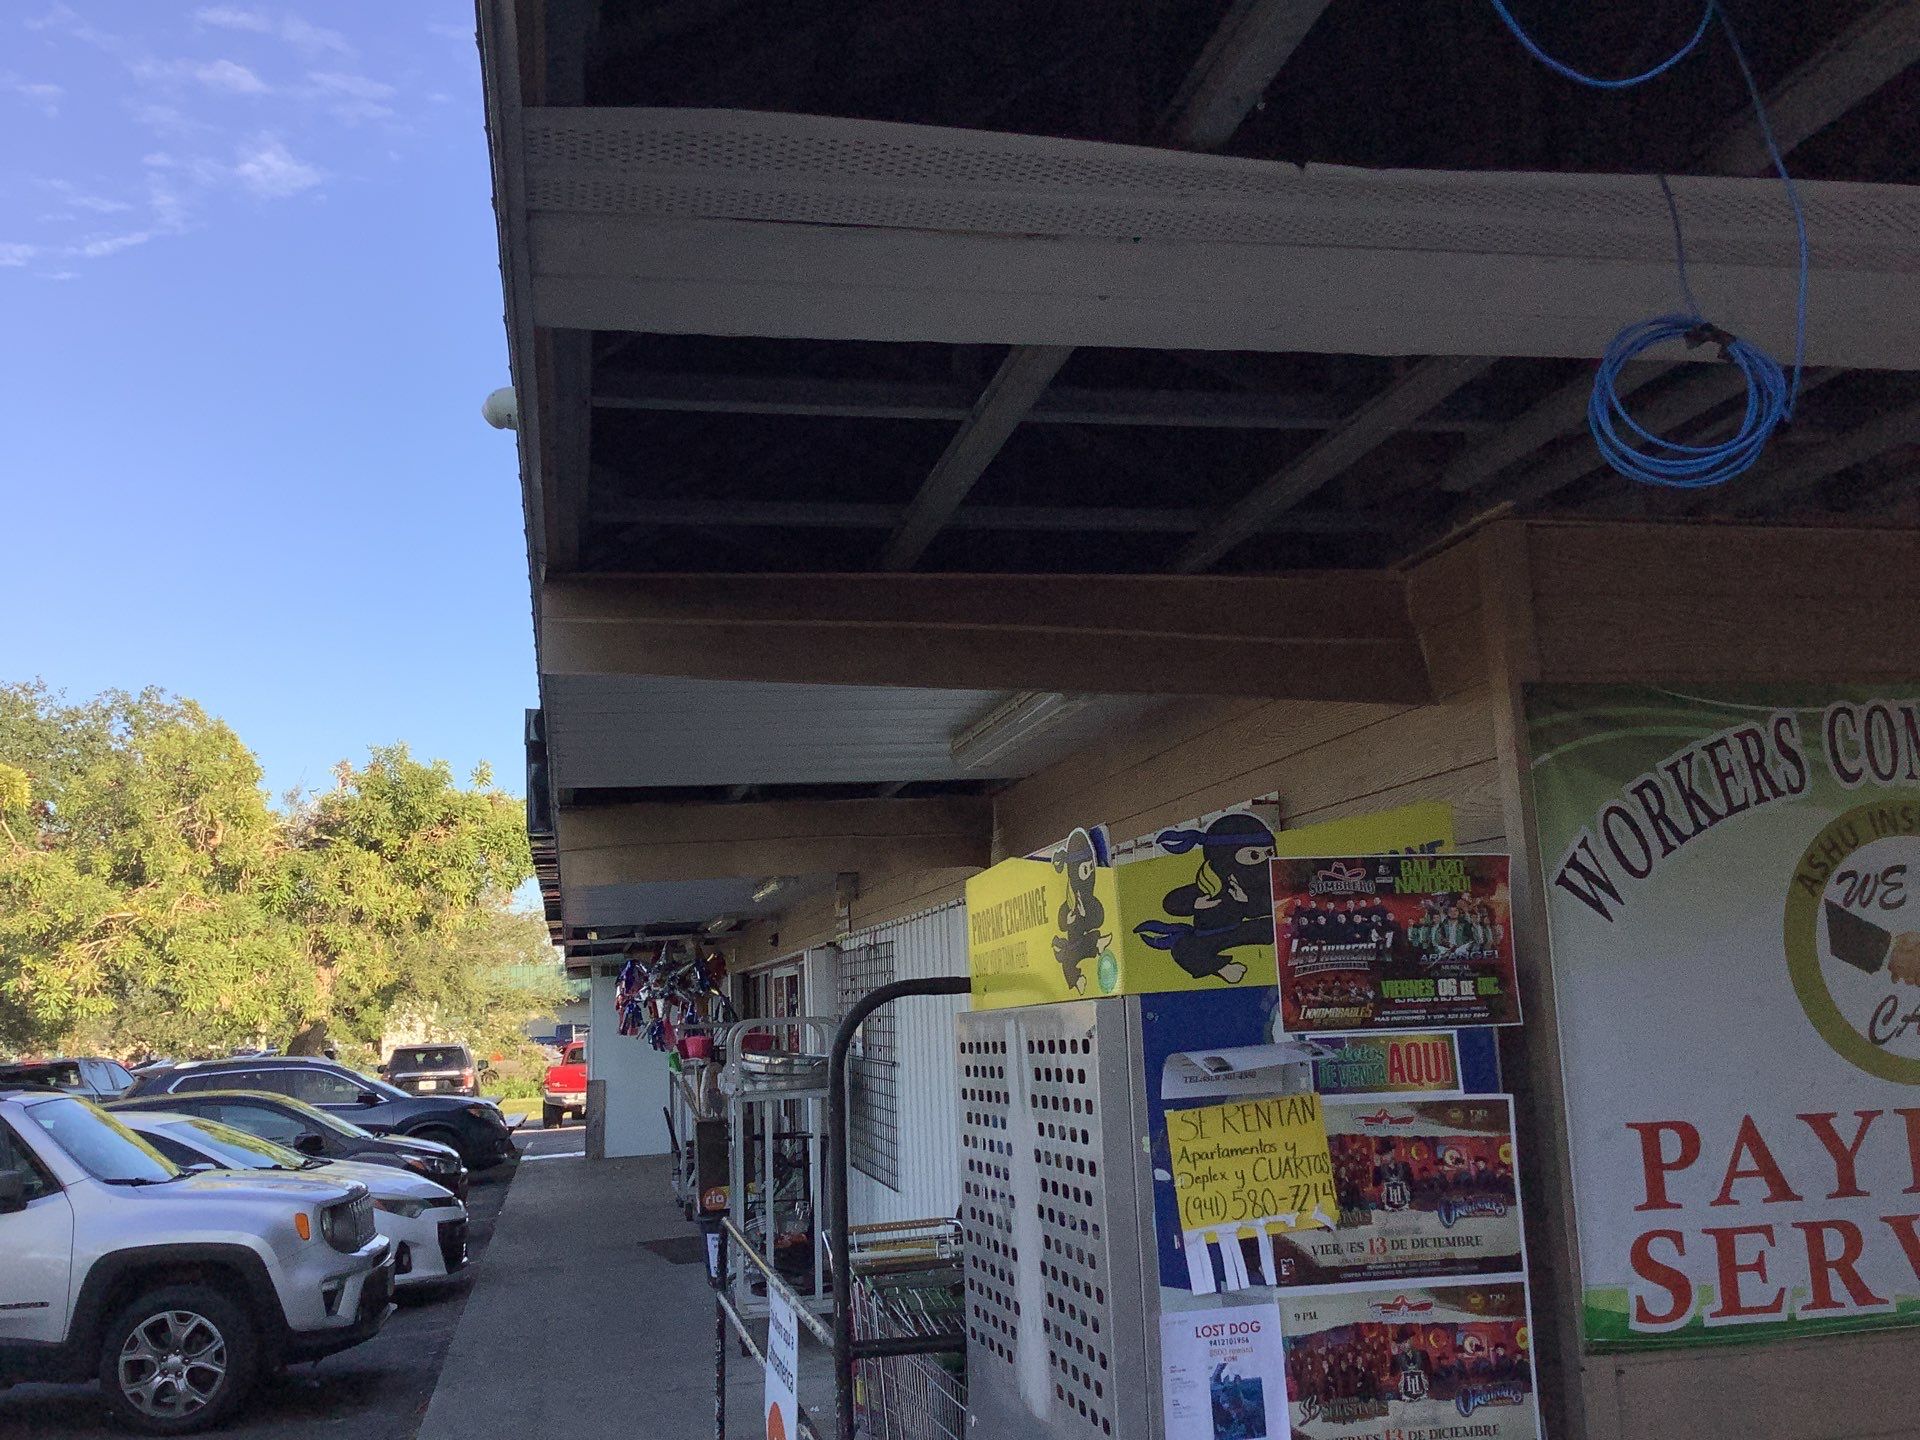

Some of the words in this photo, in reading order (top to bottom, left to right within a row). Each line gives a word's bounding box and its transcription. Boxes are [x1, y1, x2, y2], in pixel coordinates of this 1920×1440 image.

[1555, 717, 1806, 923] WORKERS
[1798, 823, 1859, 897] ASHU
[1836, 864, 1908, 911] WE
[971, 903, 1005, 946] PROPANE
[1004, 885, 1049, 936] EXCHANGE
[1381, 978, 1435, 998] VIERNES
[1438, 977, 1458, 996] 06
[1460, 979, 1476, 996] DE
[1387, 1041, 1453, 1087] AQUI
[1178, 1110, 1211, 1142] SE
[1222, 1095, 1316, 1134] RENTAN
[1253, 1152, 1330, 1183] CUARTOS
[705, 1190, 724, 1205] rio
[1368, 1237, 1388, 1255] 13
[1391, 1239, 1408, 1250] DE
[1410, 1235, 1483, 1250] DICIEMBRE
[1195, 1323, 1225, 1339] LOST
[1229, 1320, 1261, 1335] DOG
[1294, 1313, 1301, 1322] 9
[1408, 1430, 1426, 1440] DE
[1429, 1424, 1500, 1440] DICIEMBRE
